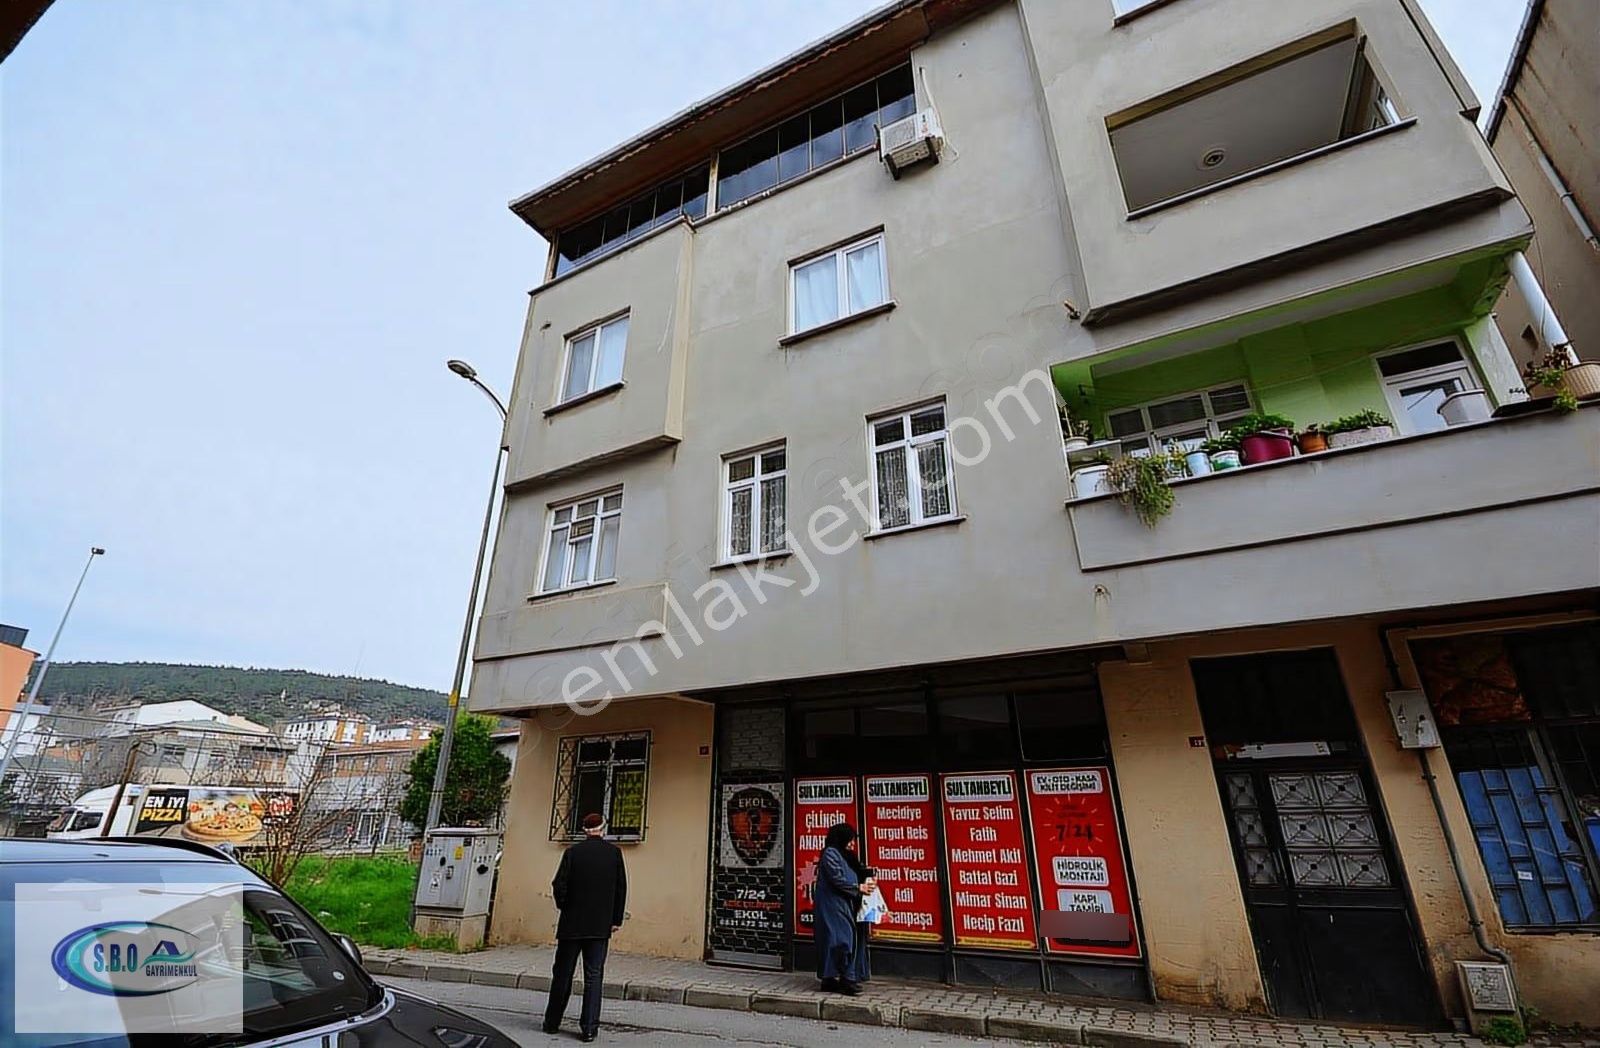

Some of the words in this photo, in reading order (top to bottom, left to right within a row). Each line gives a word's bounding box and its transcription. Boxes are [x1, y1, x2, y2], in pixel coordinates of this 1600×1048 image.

[799, 781, 852, 799] SULTANBEYLİ
[868, 779, 927, 797] SULTANBEYLİ
[946, 777, 1012, 796] SULTANBEYLİ
[145, 796, 165, 808] EN
[738, 798, 767, 809] EKOL
[877, 806, 922, 820] Mecidiye
[949, 806, 981, 821] Yavuz
[982, 805, 1014, 820] Selim
[873, 826, 904, 840] Turgut
[907, 826, 928, 840] Reis
[970, 826, 997, 842] Fatih
[878, 846, 925, 862] Hamidiye
[951, 848, 997, 863] Mehmet
[1057, 858, 1104, 871] HİDROLİK
[904, 867, 938, 882] Yesevi
[959, 870, 992, 885] Battal
[994, 869, 1018, 886] Gazi
[1059, 871, 1105, 882] MONTAJI
[736, 889, 766, 900] 7/24
[894, 887, 914, 903] Adil
[956, 891, 991, 908] Mimar
[994, 892, 1027, 909] Sinan
[1073, 893, 1097, 904] KAPI
[734, 910, 768, 920] EKOL
[888, 911, 933, 930] sanpaşa
[963, 914, 995, 933] Necip
